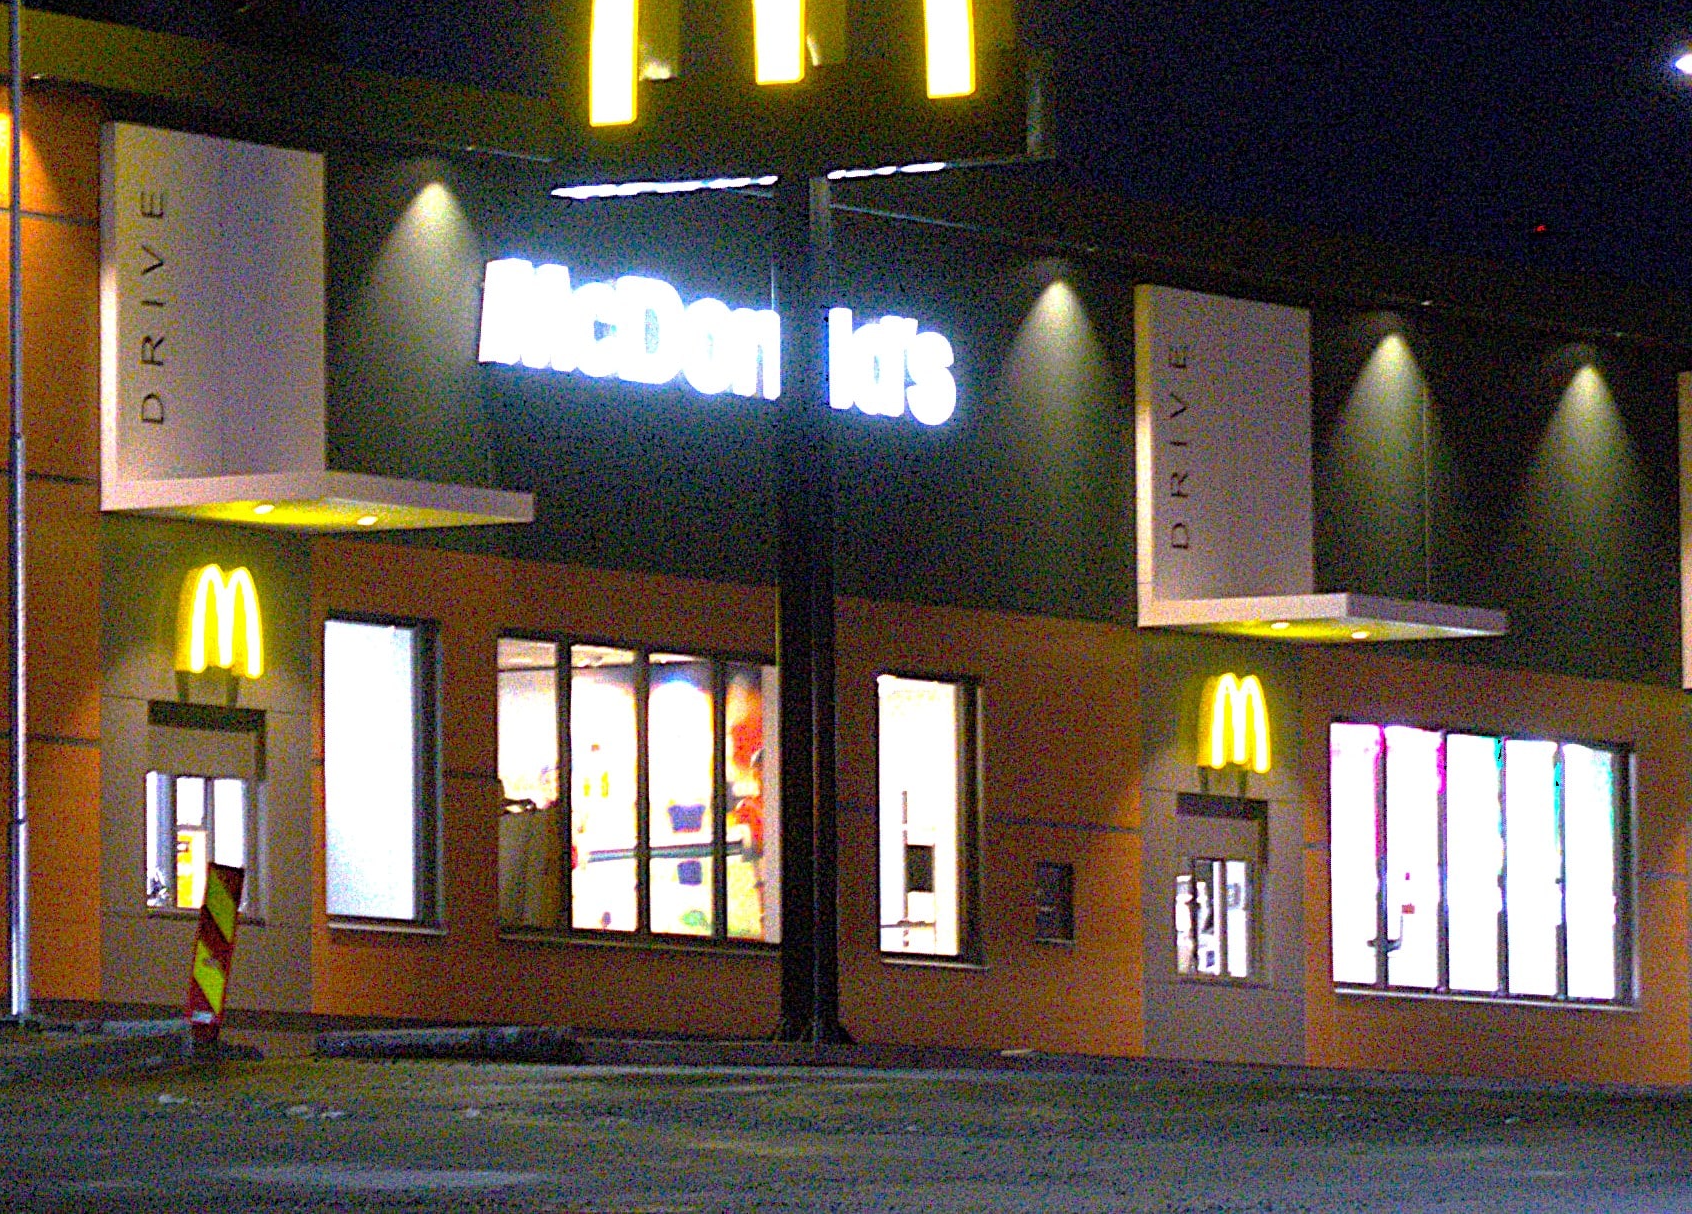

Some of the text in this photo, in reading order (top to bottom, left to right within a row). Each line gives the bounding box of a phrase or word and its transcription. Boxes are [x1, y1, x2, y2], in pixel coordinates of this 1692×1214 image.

[140, 189, 165, 426] DRIVE
[478, 257, 957, 426] McDonld's
[1168, 343, 1190, 550] DRIVE
